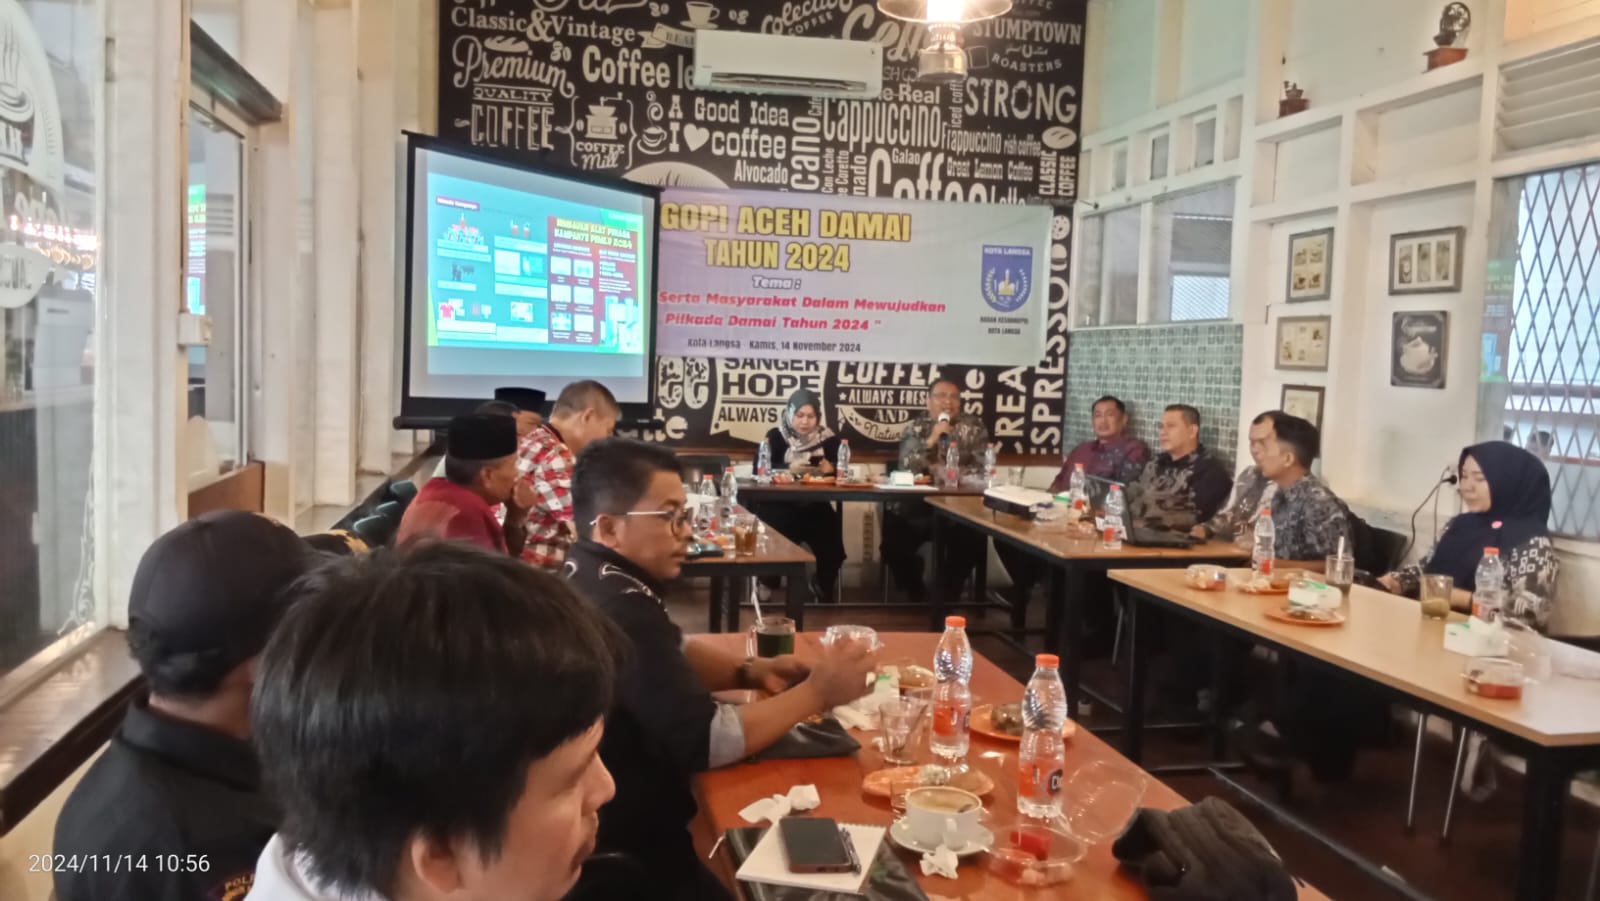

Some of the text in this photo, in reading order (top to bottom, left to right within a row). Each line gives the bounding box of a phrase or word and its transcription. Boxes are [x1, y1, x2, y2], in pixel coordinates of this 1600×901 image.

[973, 18, 1082, 45] STUMPTOWN
[452, 35, 575, 98] Premium
[582, 45, 696, 91] Coffee le
[991, 53, 1063, 73] ROASTERS
[473, 87, 552, 101] QUALITY
[899, 84, 940, 105] Real
[964, 77, 1077, 124] STRONG
[668, 94, 789, 127] A Good Idea
[471, 104, 555, 150] COFFEE
[823, 97, 941, 153] Cappuccino
[576, 142, 624, 153] COFFEE
[669, 122, 787, 160] I coffee
[942, 121, 1002, 156] Frappuccino
[582, 150, 620, 170] Mill
[791, 117, 821, 190] cano
[734, 159, 789, 184] Alvocado
[851, 155, 867, 196] nado
[1039, 150, 1057, 195] CLASSIC
[1058, 155, 1076, 196] COFFEE
[737, 206, 811, 237] ACEH
[819, 209, 912, 242] DAMAI
[704, 238, 851, 272] TAHUN 2024
[752, 275, 793, 290] Tema
[658, 291, 946, 313] Serta Masyarakat Dalam Mewujudkan
[665, 312, 723, 326] Pilkada
[728, 315, 777, 328] Damai
[782, 316, 828, 330] Tahun
[832, 318, 869, 331] 2024
[781, 341, 790, 350] 14
[793, 341, 837, 351] November
[839, 343, 861, 352] 2024
[722, 372, 821, 397] HOPE
[849, 389, 929, 406] ALWAYS FRES
[718, 407, 778, 422] ALWAYS
[874, 408, 910, 423] AND
[864, 422, 901, 441] Natur
